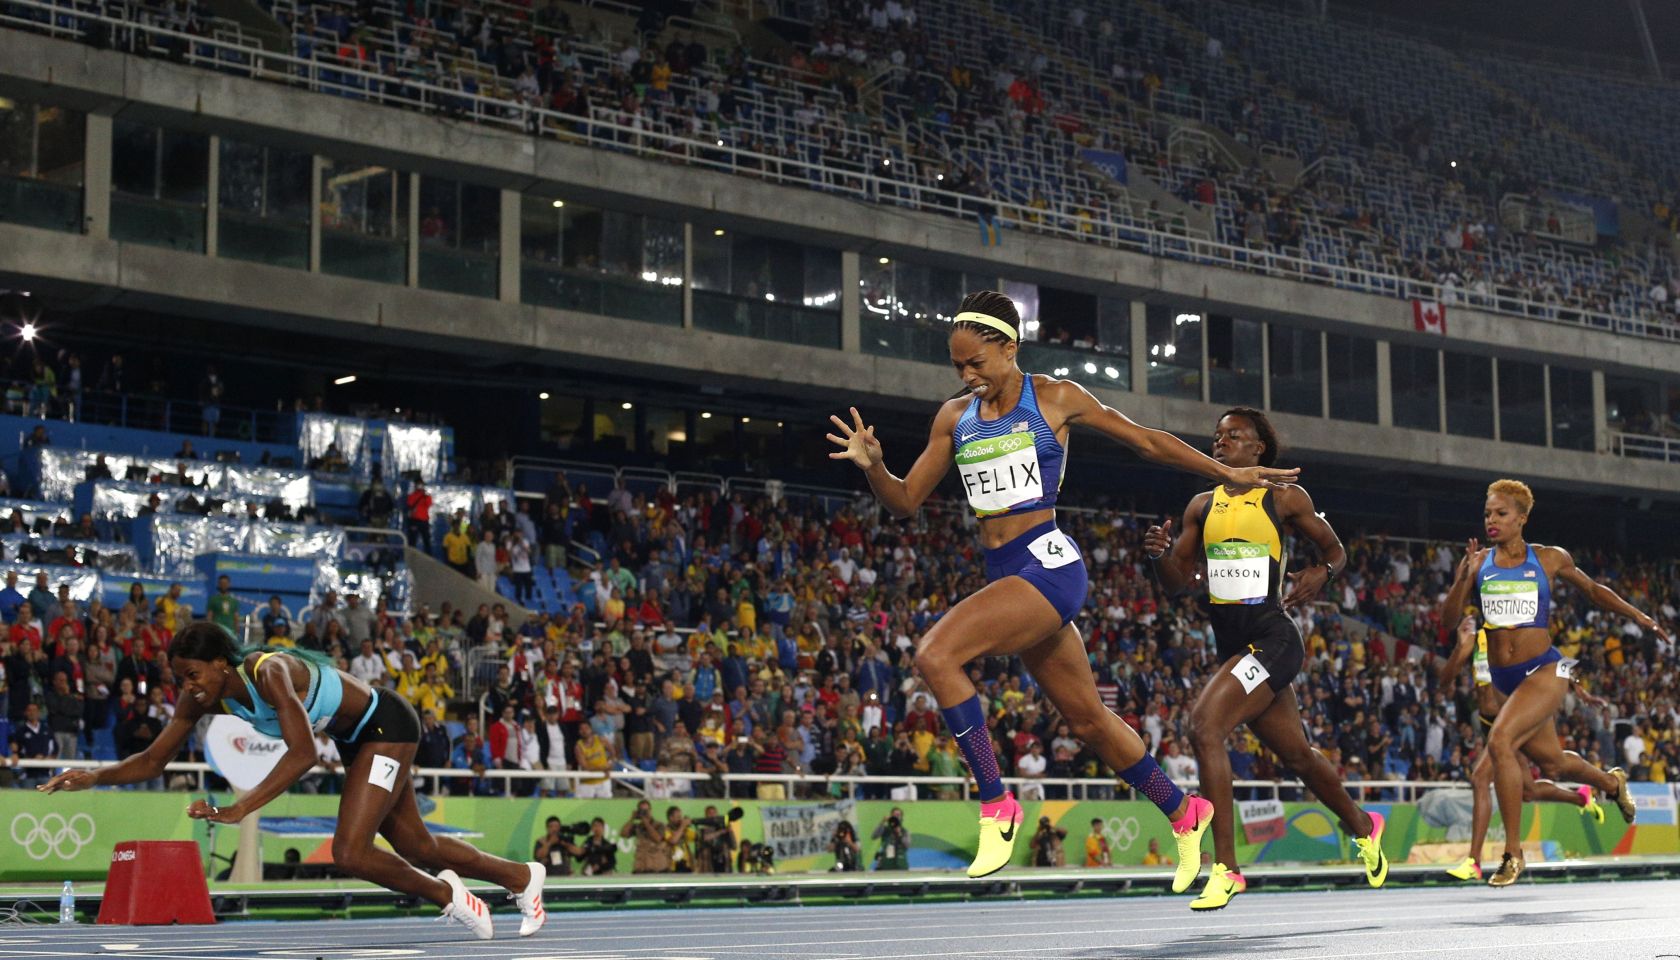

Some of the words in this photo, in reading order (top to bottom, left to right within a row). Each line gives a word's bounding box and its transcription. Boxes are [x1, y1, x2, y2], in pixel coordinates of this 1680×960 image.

[963, 461, 1039, 497] FELIX
[1047, 540, 1064, 558] 4
[1210, 568, 1260, 579] JACKSON
[1483, 599, 1536, 616] HASTINGS
[248, 742, 281, 753] IAAF
[384, 762, 395, 780] 7
[118, 849, 136, 862] OMEGA
